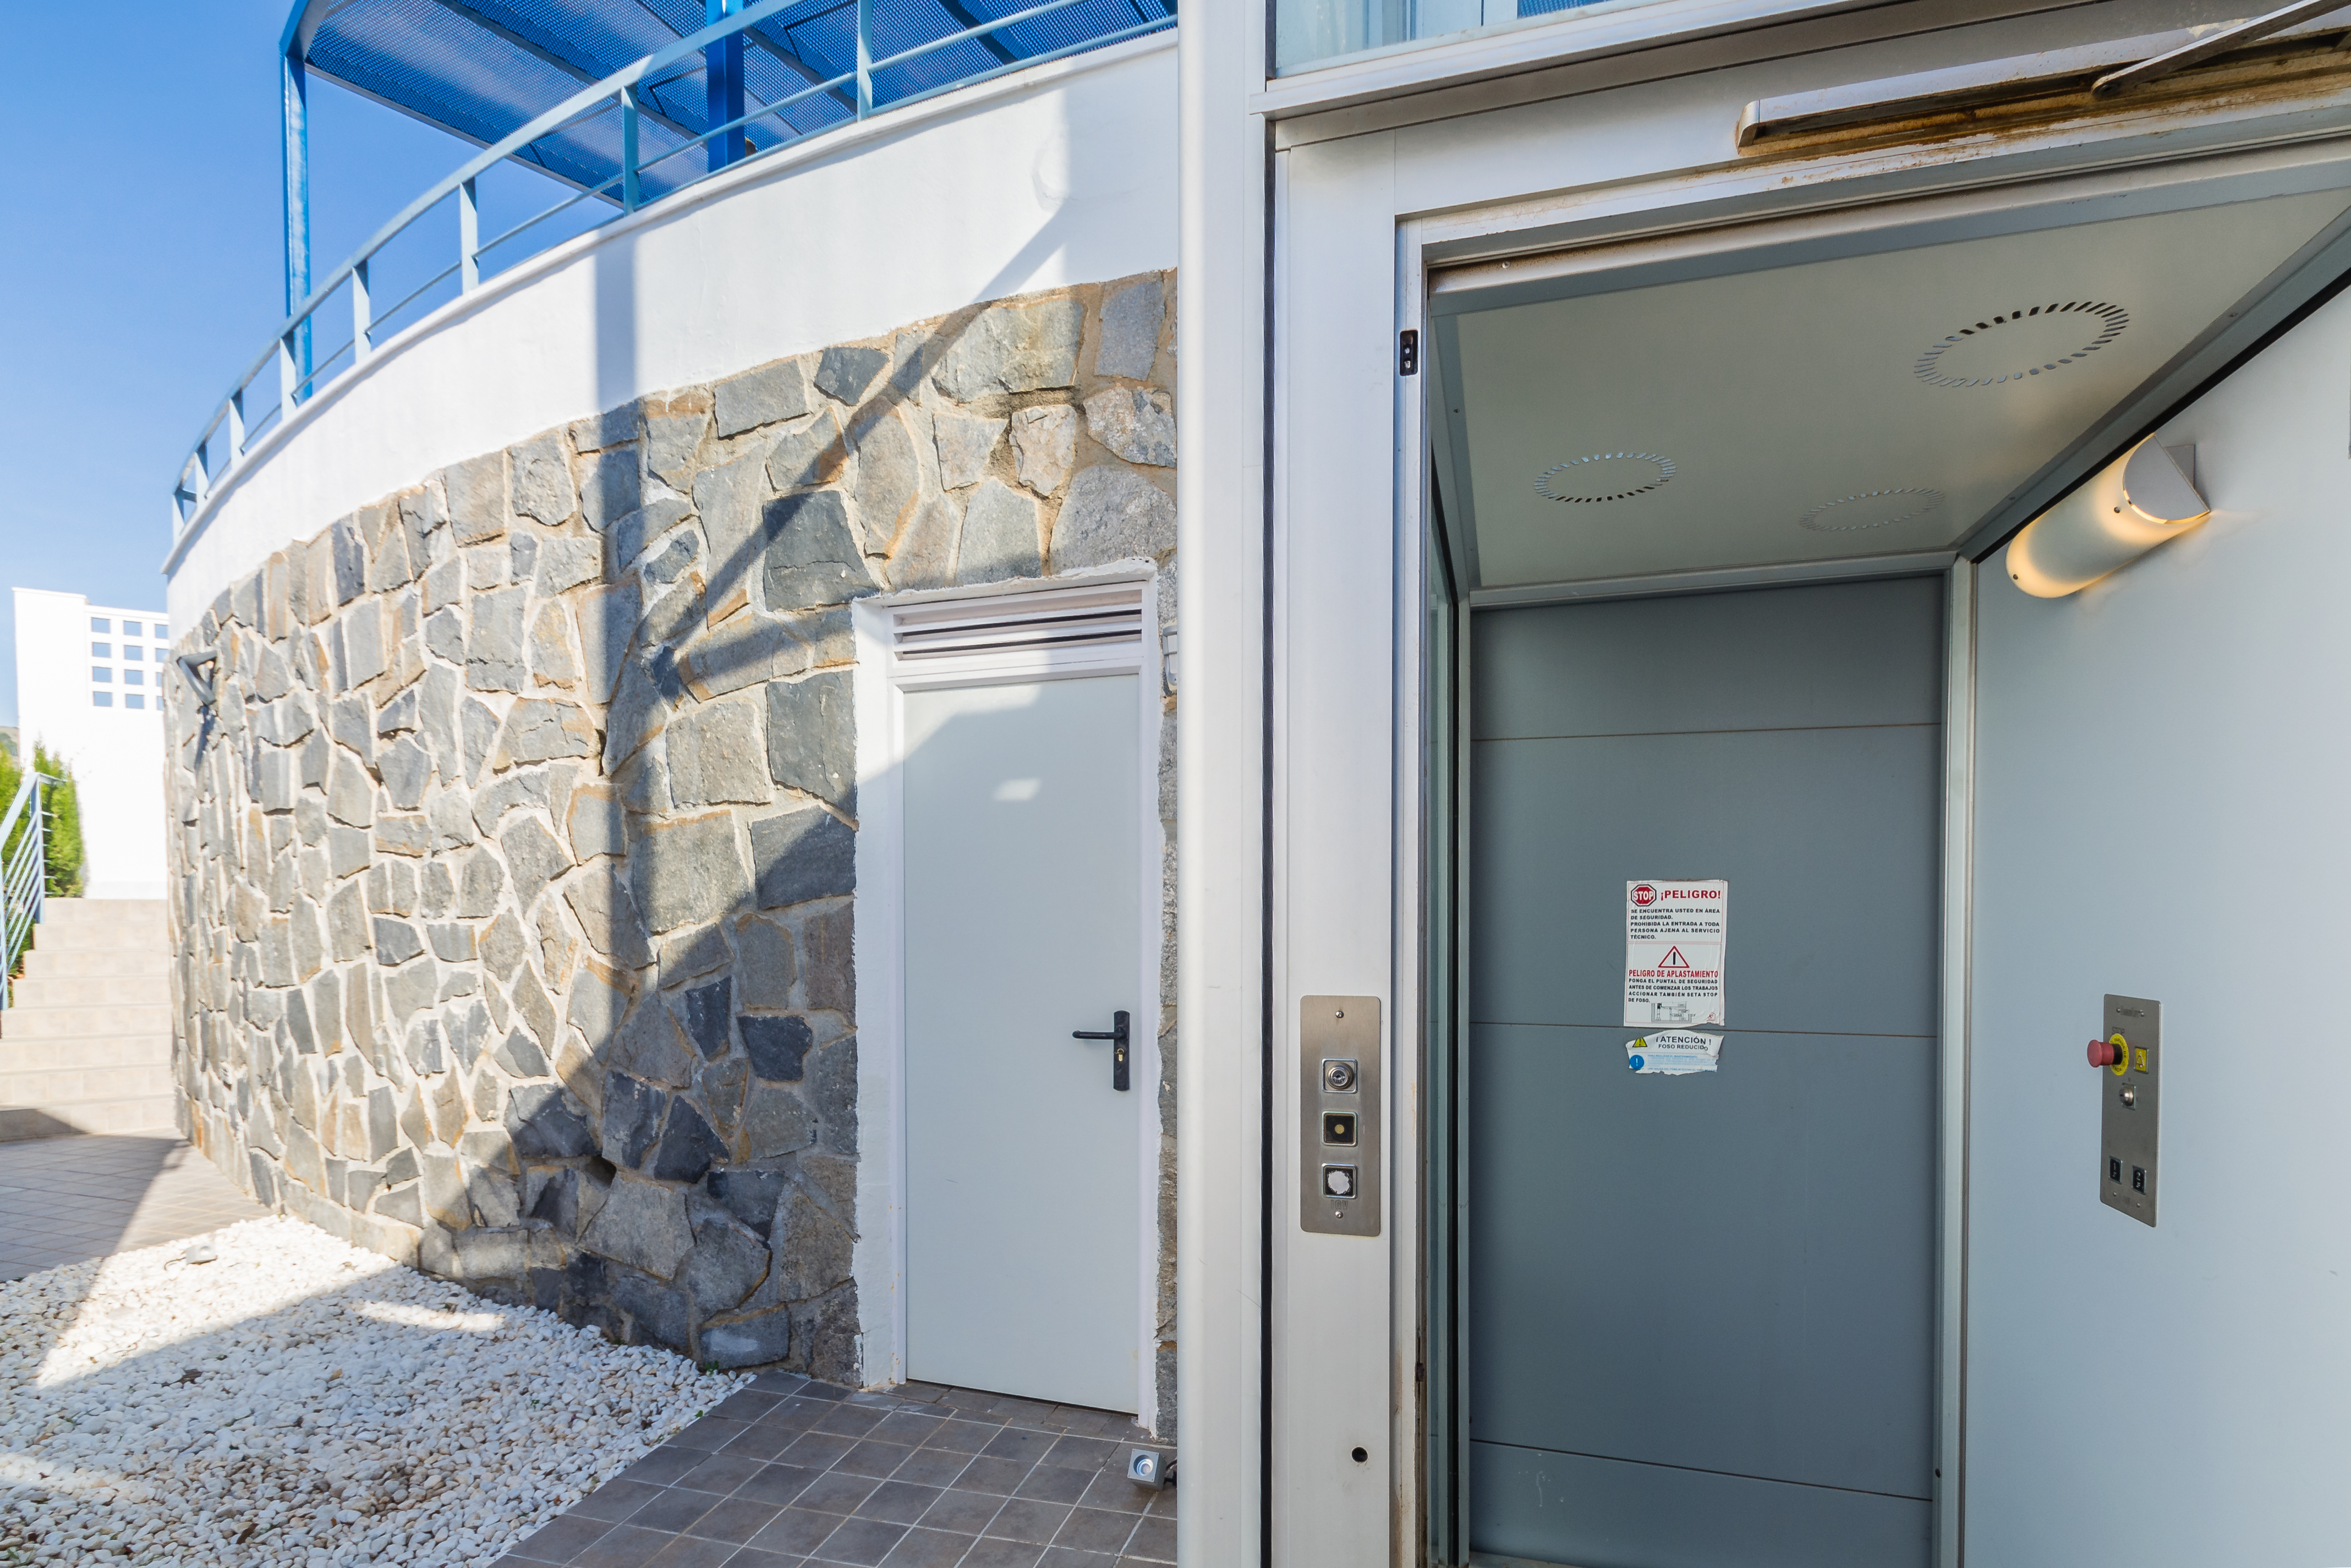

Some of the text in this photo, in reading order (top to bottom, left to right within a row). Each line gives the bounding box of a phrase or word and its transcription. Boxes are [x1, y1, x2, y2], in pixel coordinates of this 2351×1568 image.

[1634, 891, 1653, 901] STOP
[1661, 890, 1720, 901] ¡PELIGRO!
[1330, 1199, 1349, 1210] IGV
